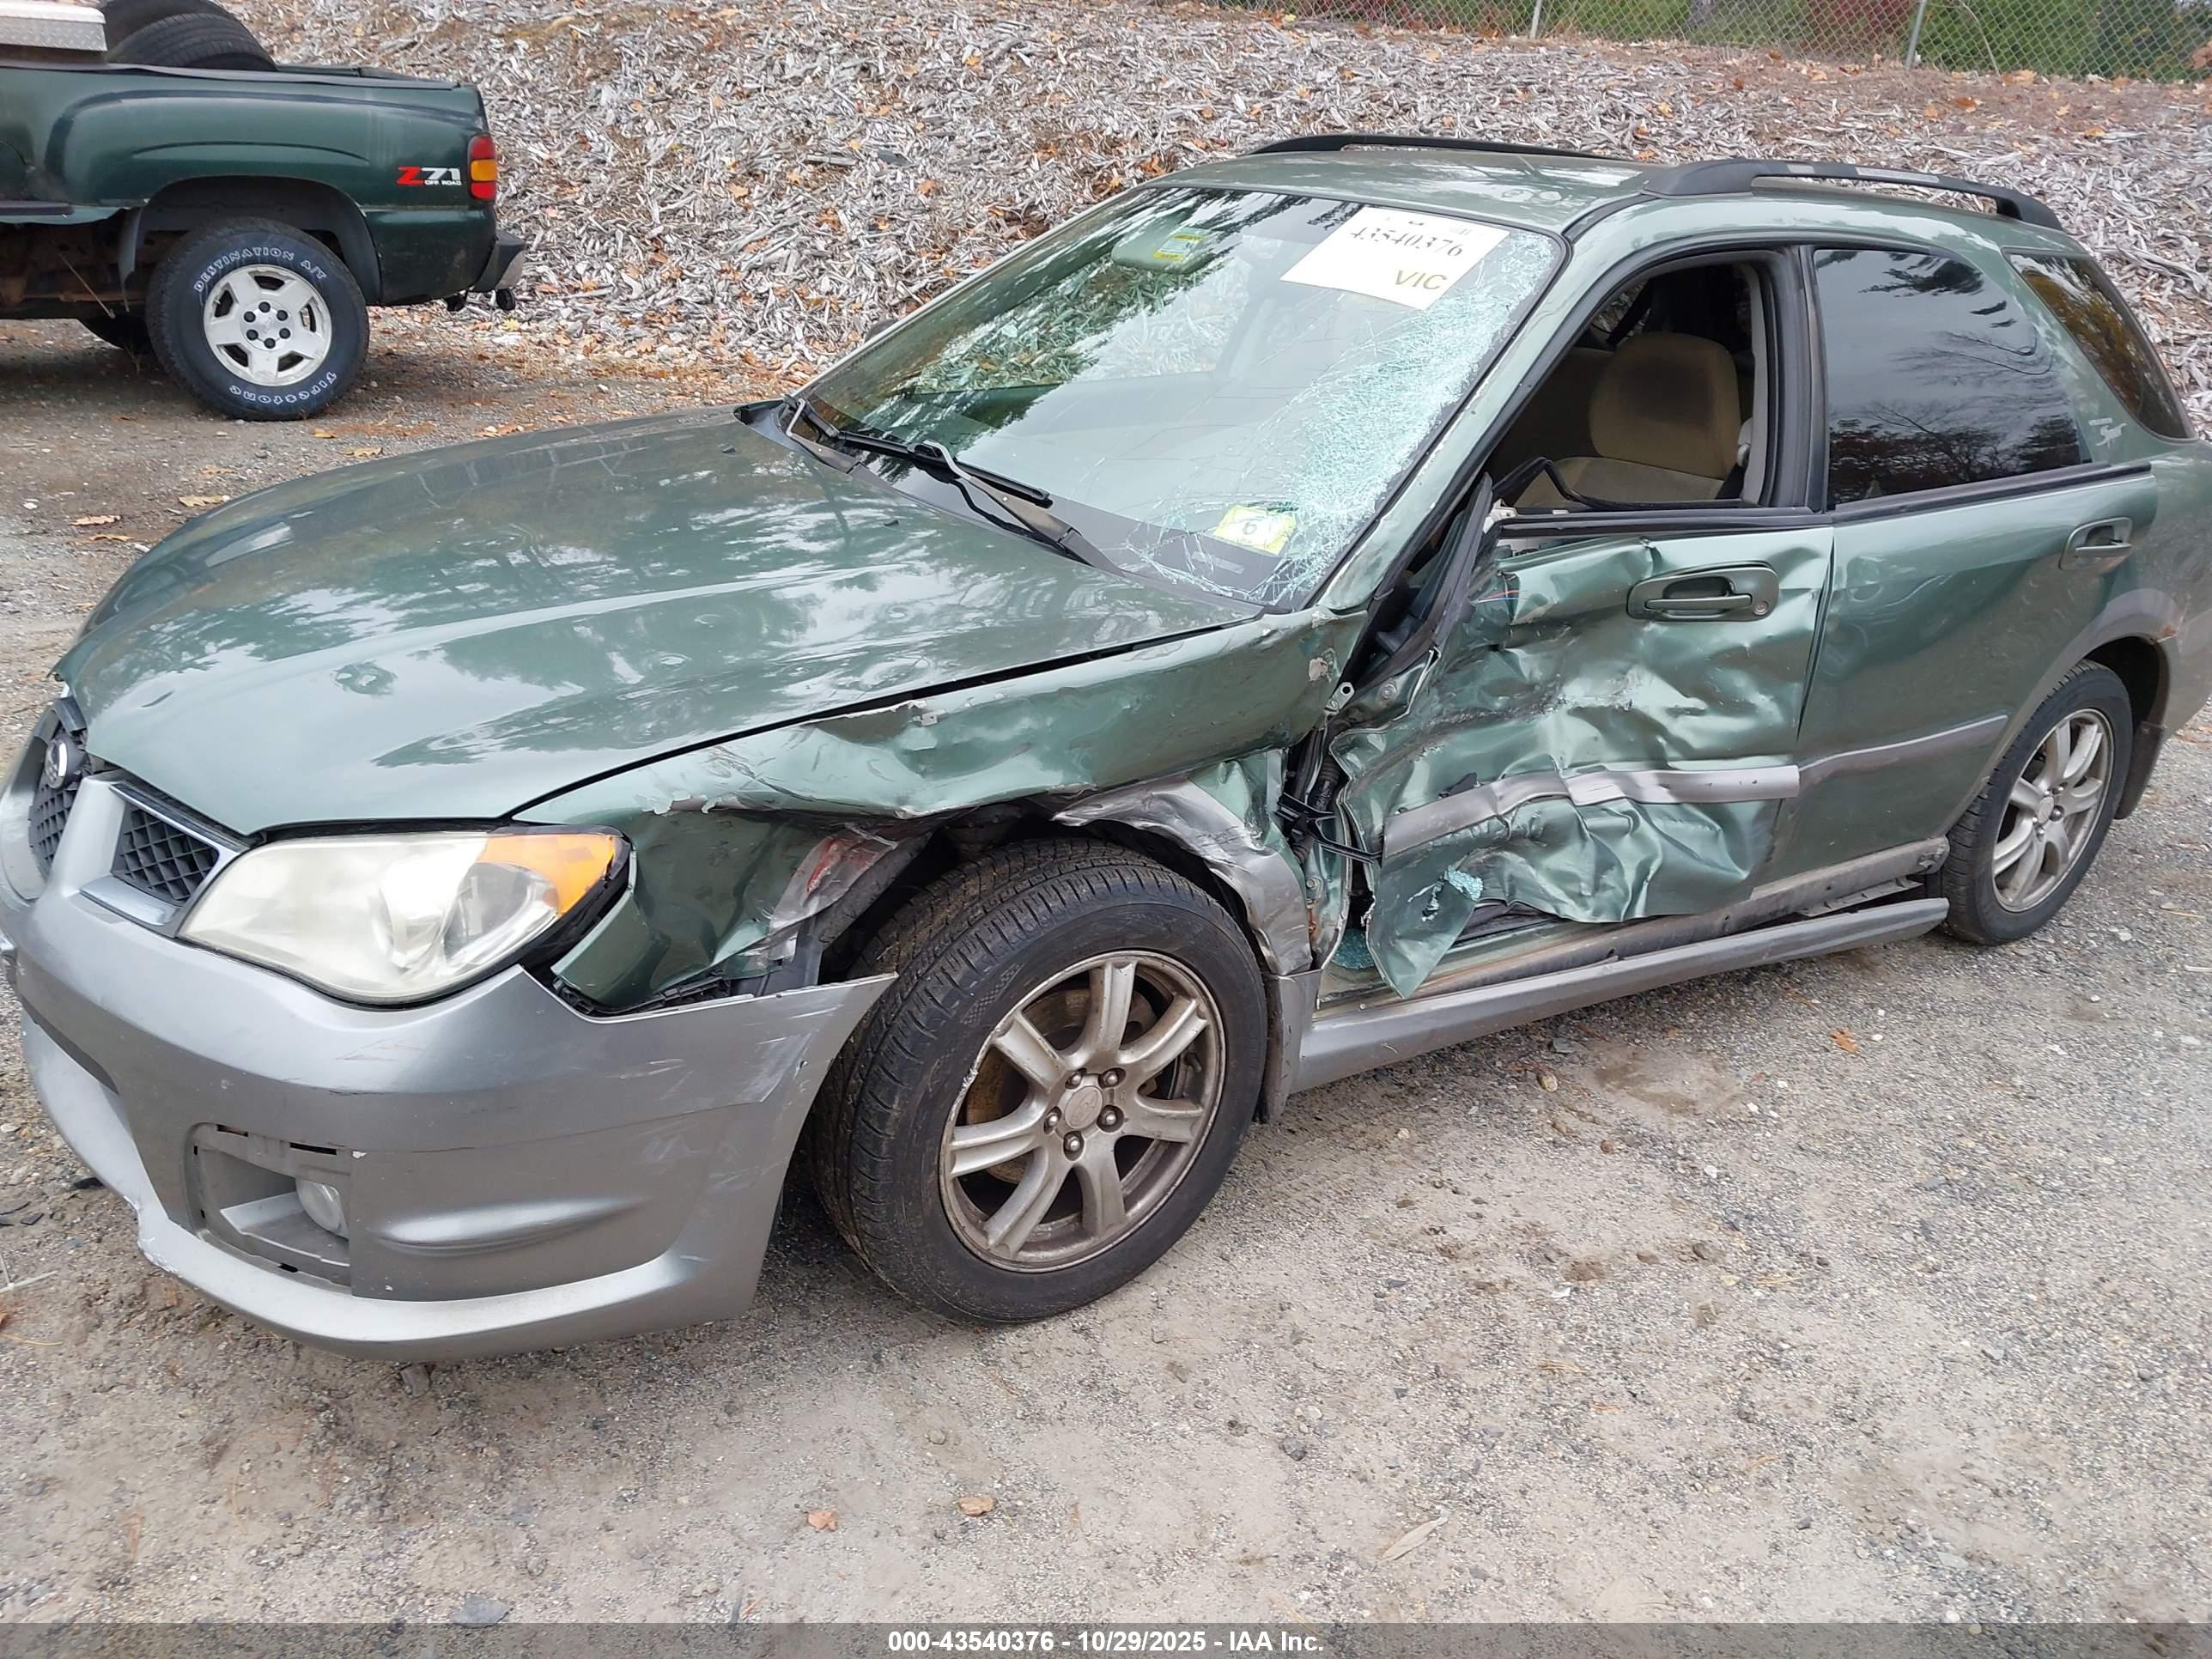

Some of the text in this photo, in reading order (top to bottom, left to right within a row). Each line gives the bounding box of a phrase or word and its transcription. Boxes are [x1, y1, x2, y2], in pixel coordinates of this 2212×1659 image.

[397, 166, 461, 185] Z71
[1350, 226, 1464, 257] 43540376
[193, 246, 327, 292] DESTINATION A/T
[1395, 269, 1448, 291] VIC
